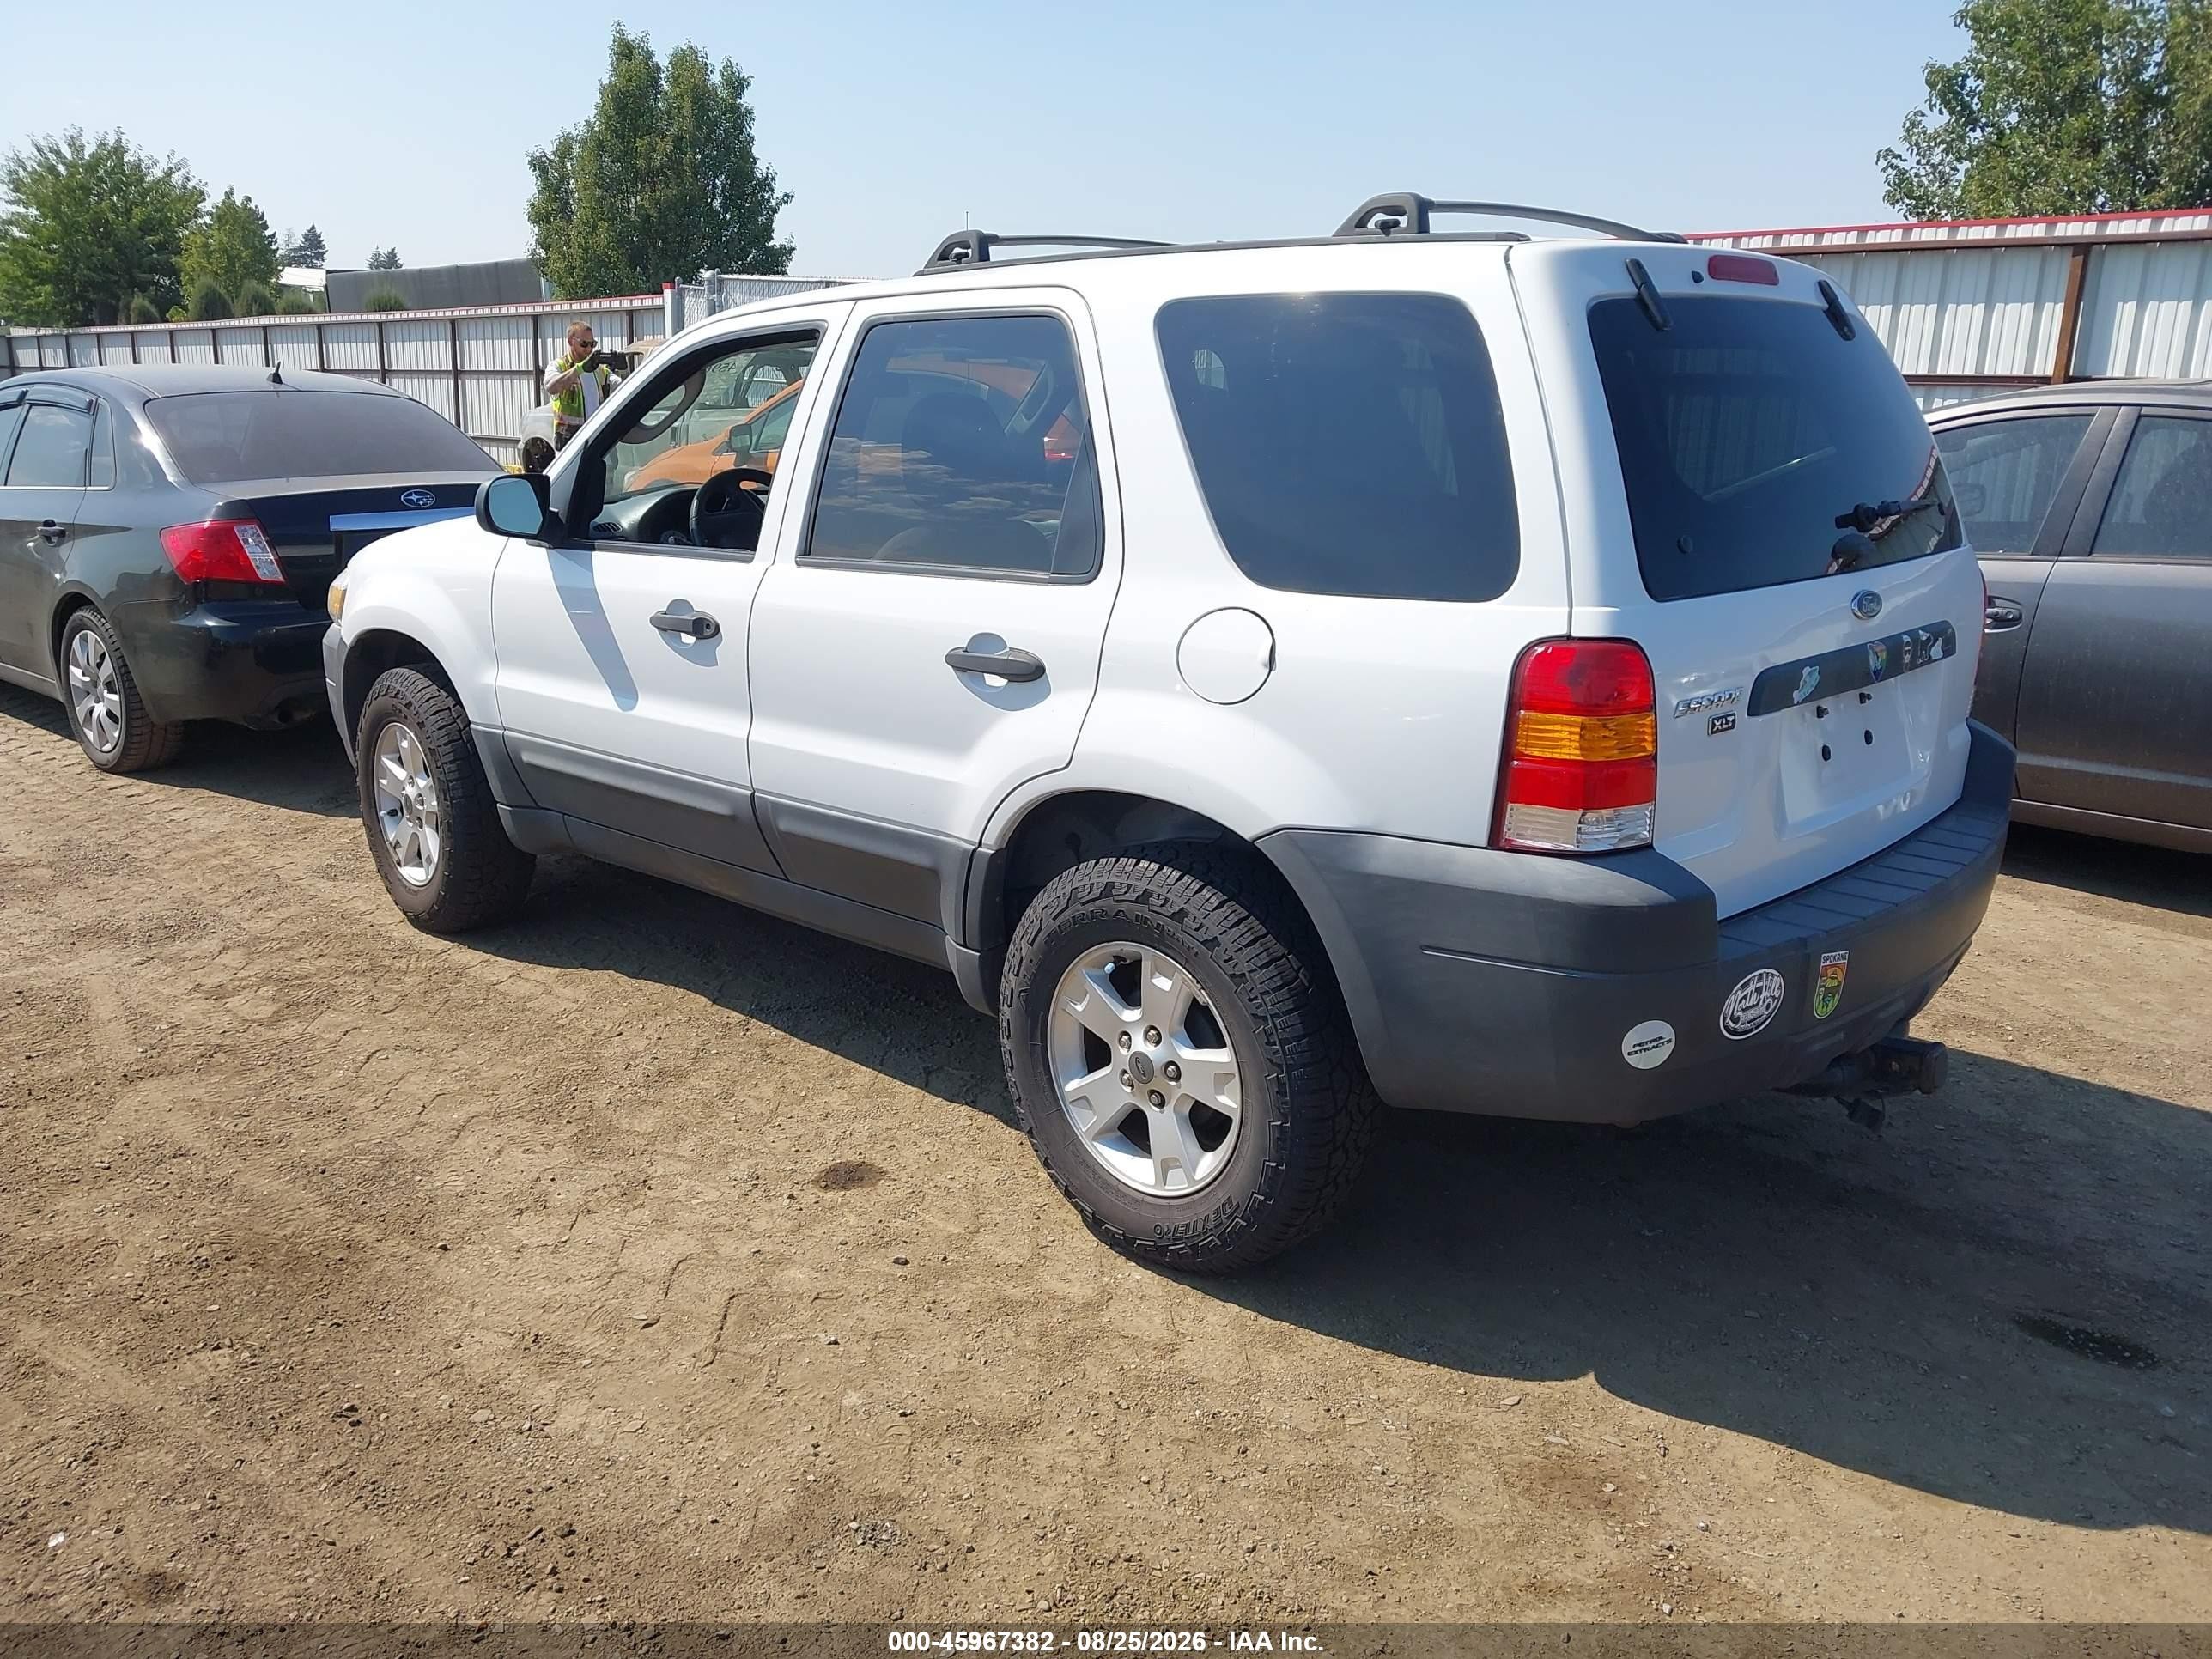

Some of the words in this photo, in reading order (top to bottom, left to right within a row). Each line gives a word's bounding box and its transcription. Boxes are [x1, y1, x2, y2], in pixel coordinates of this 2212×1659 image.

[1713, 715, 1735, 732] XLT
[1822, 952, 1847, 964] SPOKANE
[1627, 1038, 1672, 1056] EXTRACTS
[1632, 1036, 1666, 1048] PETROL
